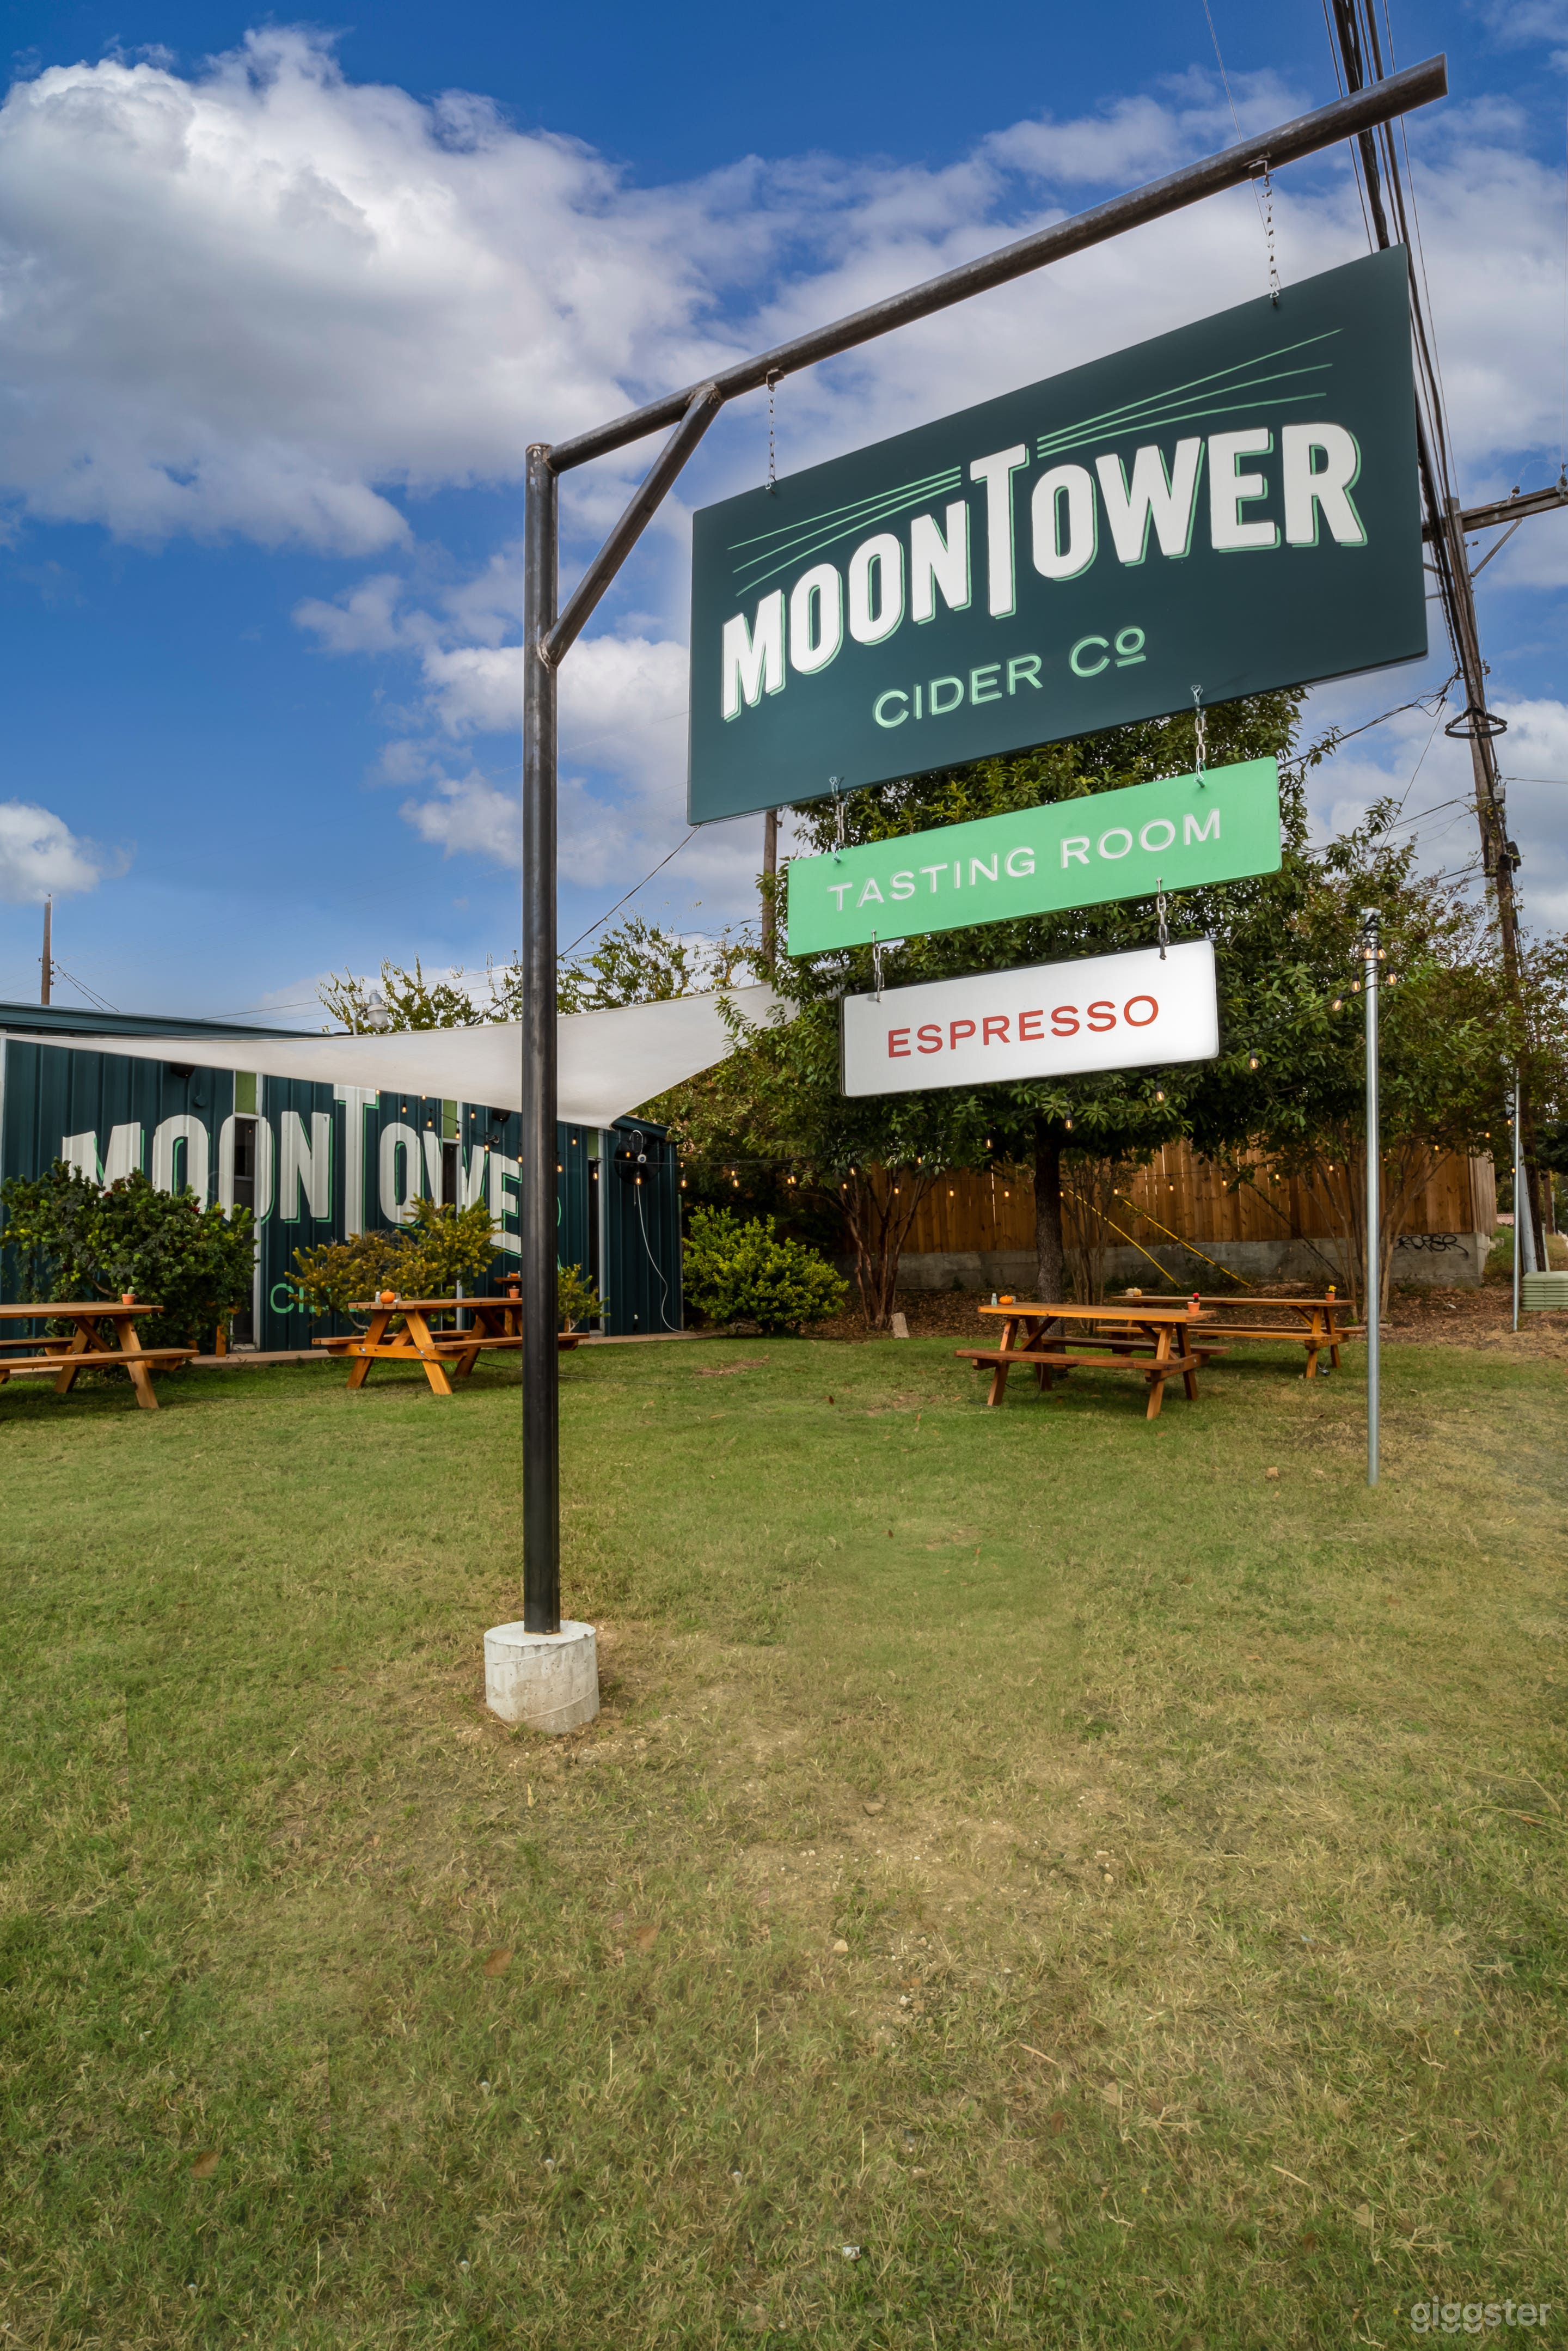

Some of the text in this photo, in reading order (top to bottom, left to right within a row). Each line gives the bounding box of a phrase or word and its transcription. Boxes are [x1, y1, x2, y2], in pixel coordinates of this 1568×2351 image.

[721, 423, 1368, 722] MOONTOWER
[873, 653, 1043, 728] CIDER
[827, 808, 1221, 911] TASTING ROOM
[887, 996, 1159, 1058] ESPRESSO
[62, 1083, 561, 1258] MOONTOWE
